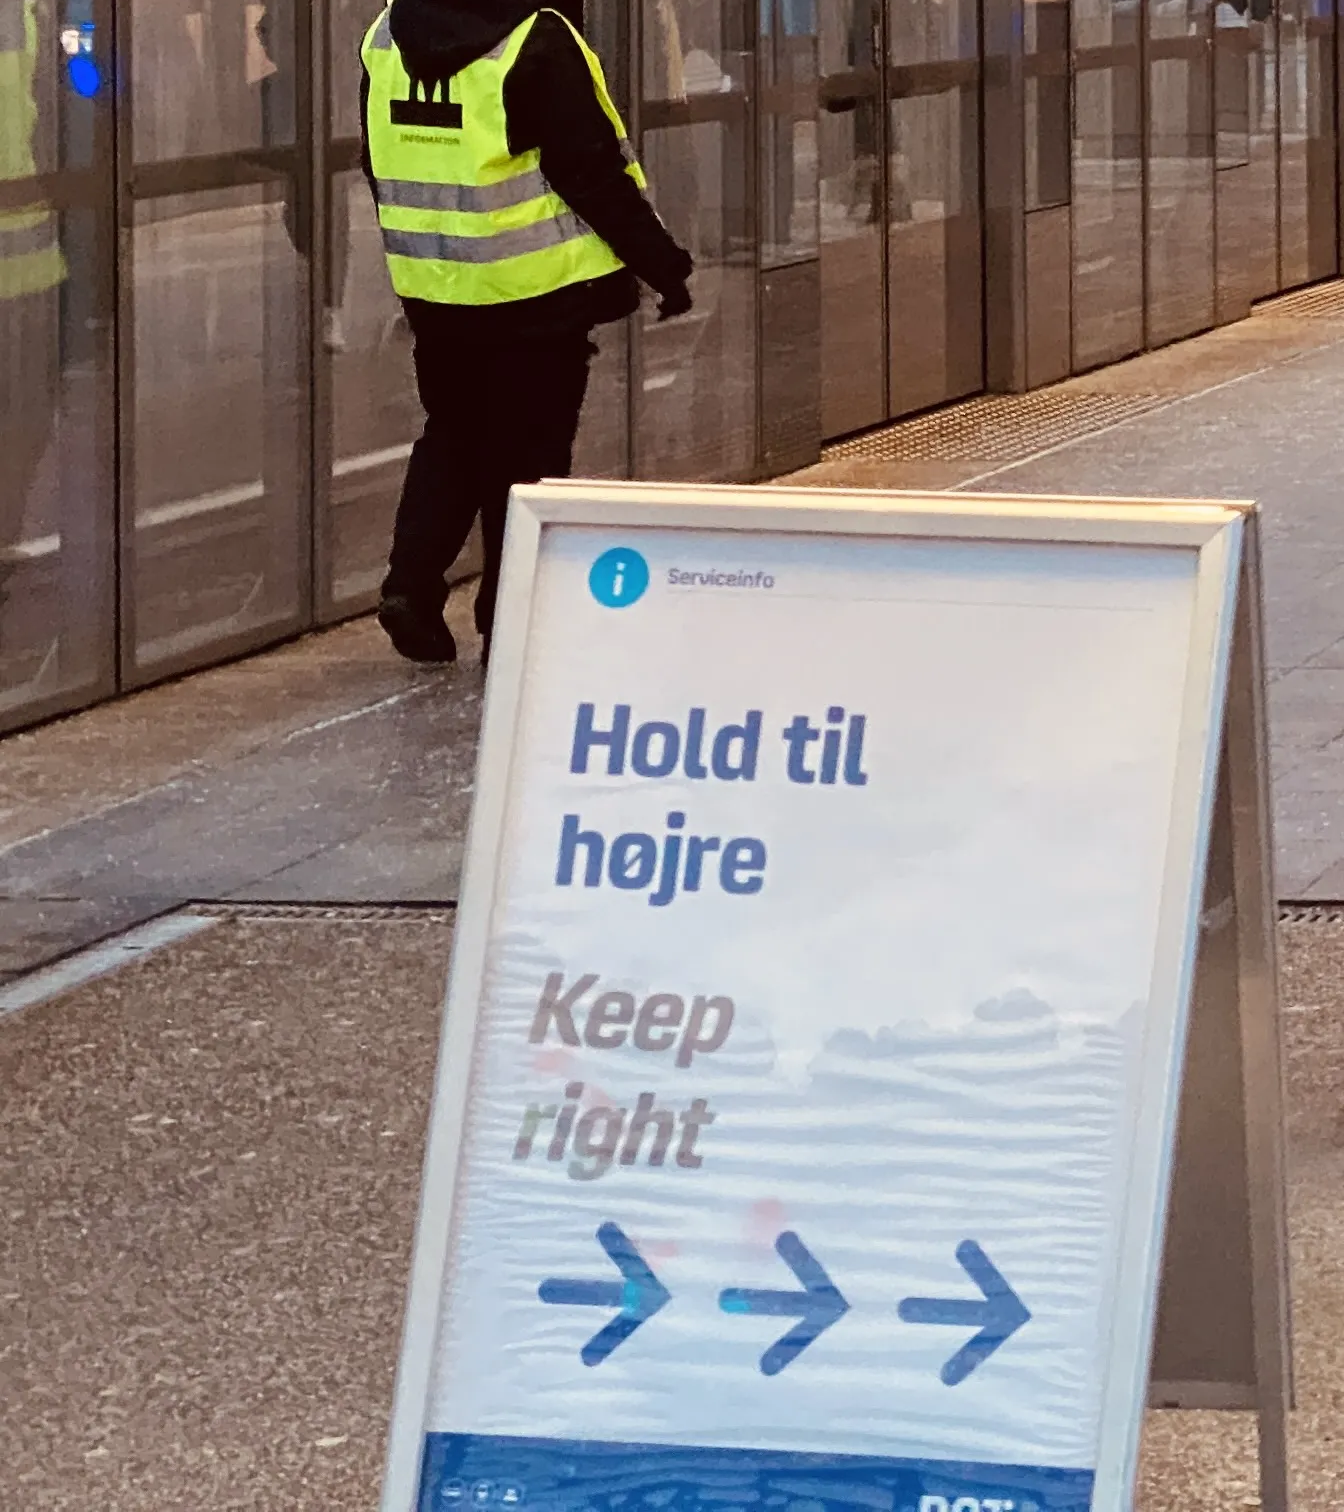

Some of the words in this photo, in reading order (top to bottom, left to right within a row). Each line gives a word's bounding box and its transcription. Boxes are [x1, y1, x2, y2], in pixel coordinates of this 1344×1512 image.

[667, 567, 775, 590] Serviceinfo
[569, 702, 762, 781] Hold
[782, 706, 869, 786] til
[555, 812, 767, 907] højre
[528, 971, 736, 1069] Keep
[512, 1082, 716, 1183] right
